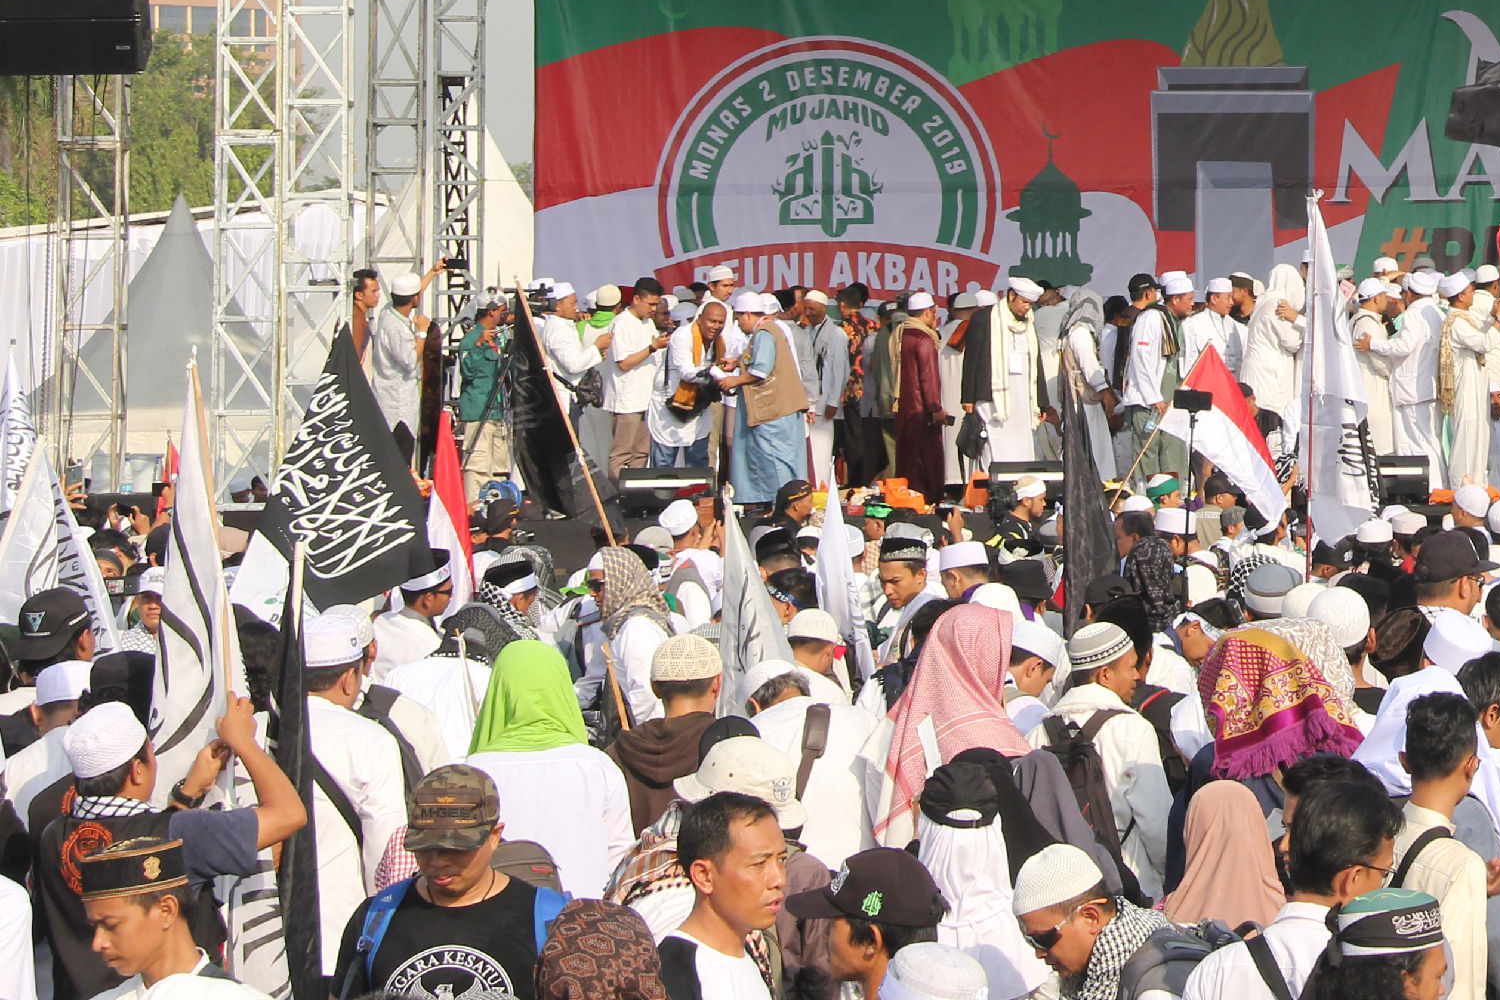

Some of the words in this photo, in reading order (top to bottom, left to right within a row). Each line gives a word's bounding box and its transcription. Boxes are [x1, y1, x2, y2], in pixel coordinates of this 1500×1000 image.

[689, 96, 752, 180] MONAS
[758, 80, 776, 102] 2
[785, 65, 922, 115] DESEMBER
[921, 114, 968, 176] 2019
[764, 97, 891, 144] MUJAHID
[829, 251, 959, 299] AKBAR
